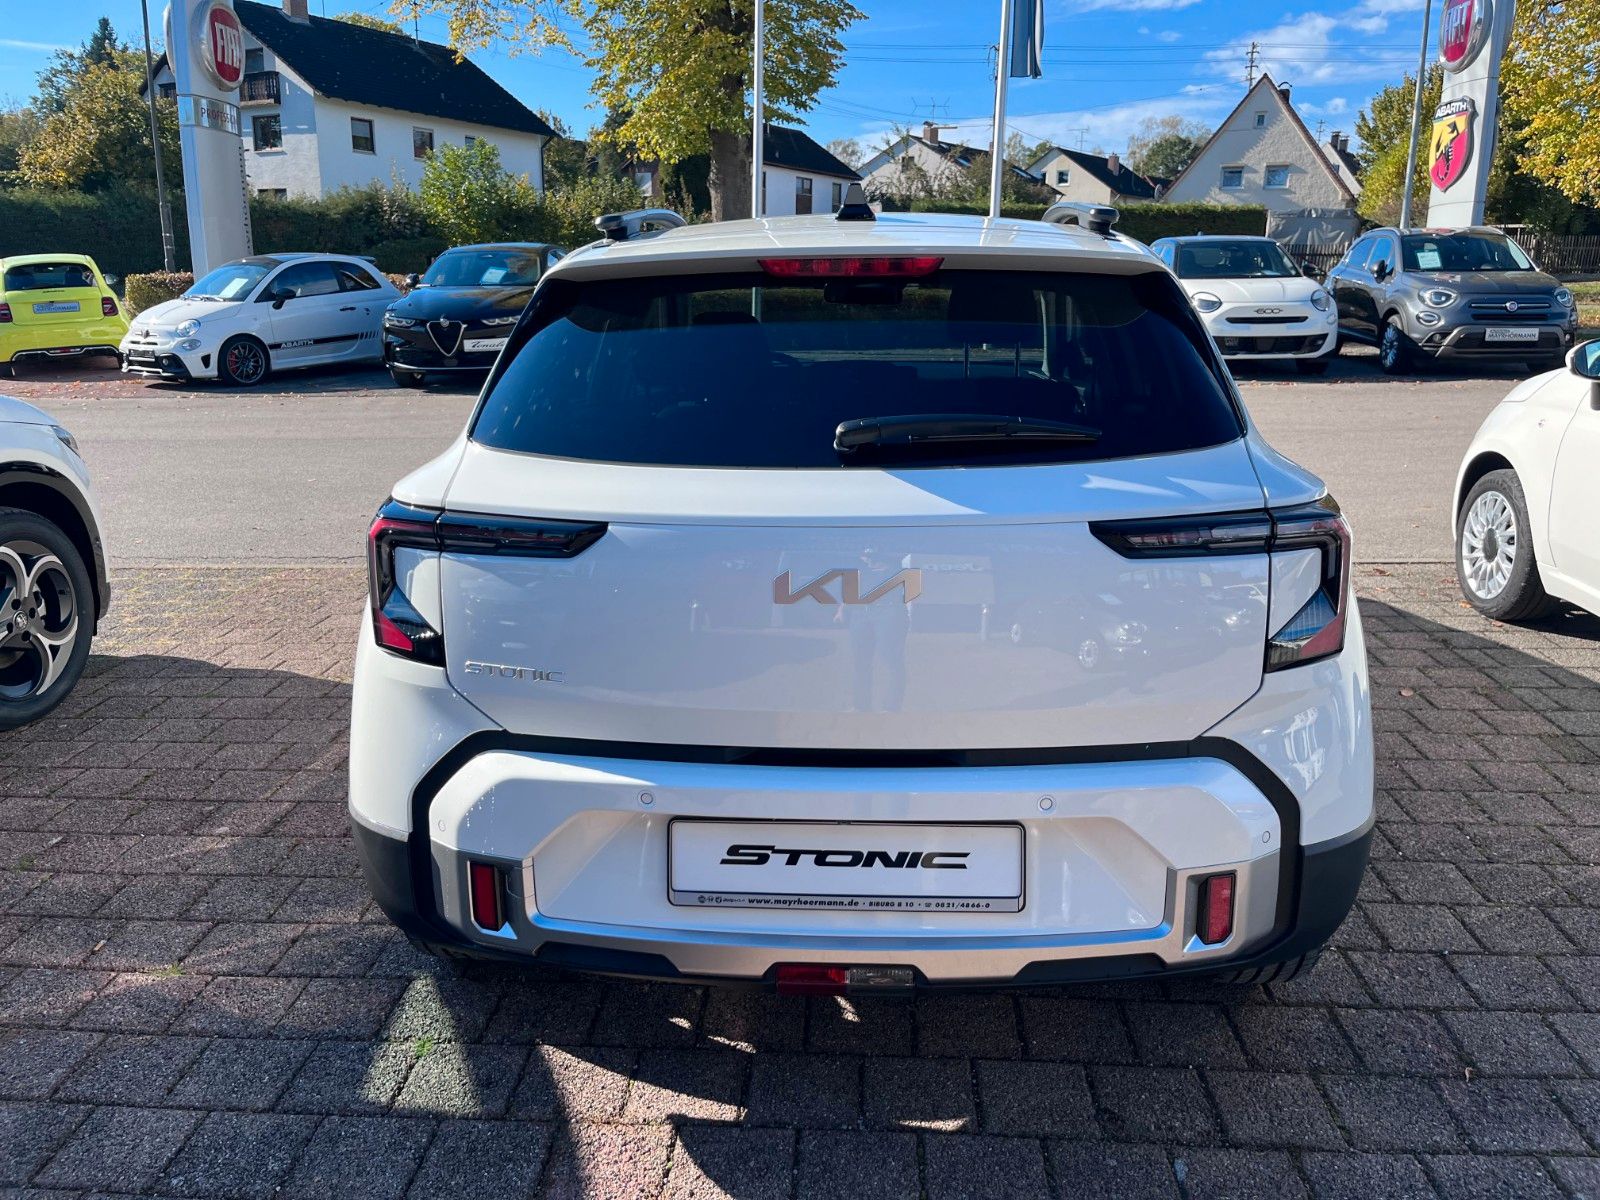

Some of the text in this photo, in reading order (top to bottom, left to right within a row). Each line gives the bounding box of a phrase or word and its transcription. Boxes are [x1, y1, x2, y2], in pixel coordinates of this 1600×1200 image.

[1435, 101, 1467, 118] ABARTH
[281, 340, 314, 349] ABARTH
[464, 660, 564, 683] STONIC
[719, 844, 971, 869] STONIC
[748, 897, 859, 907] www.mayrhoermann.de
